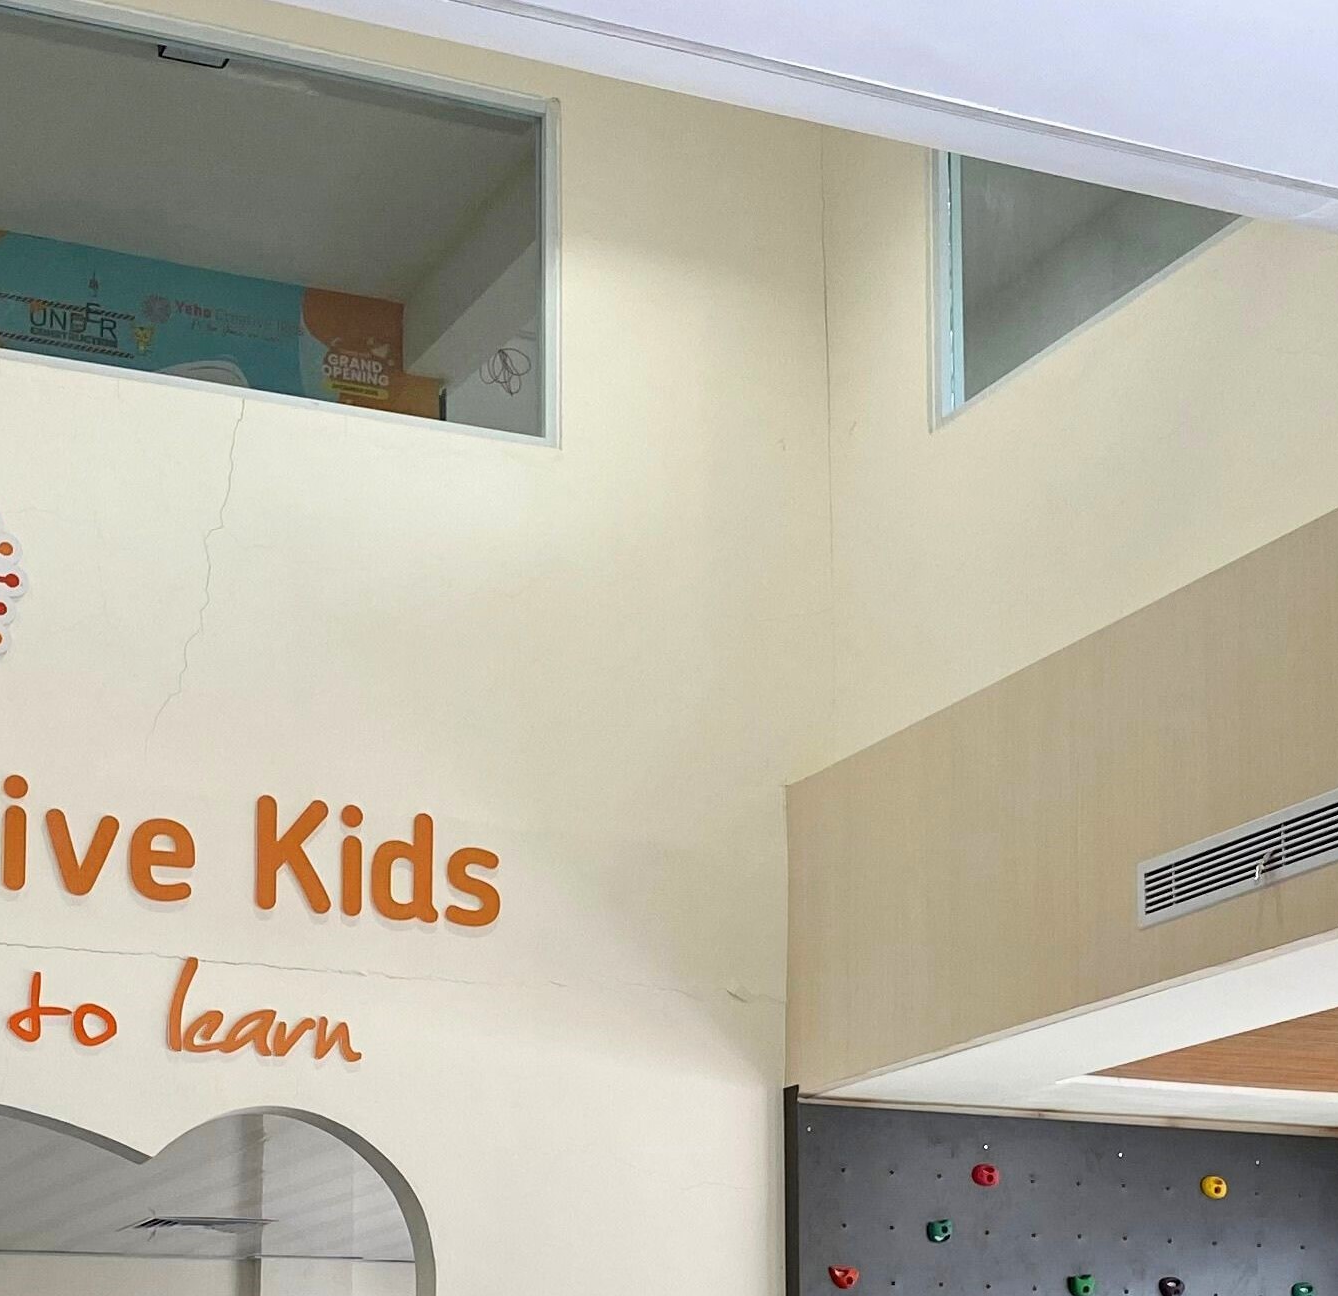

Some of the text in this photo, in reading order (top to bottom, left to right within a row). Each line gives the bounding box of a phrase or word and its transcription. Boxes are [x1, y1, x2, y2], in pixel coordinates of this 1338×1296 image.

[30, 302, 118, 341] UNDER
[322, 364, 389, 386] OPENING
[327, 353, 382, 373] GRAND
[256, 794, 501, 927] Kids
[8, 972, 117, 1047] to
[167, 957, 363, 1062] learn
